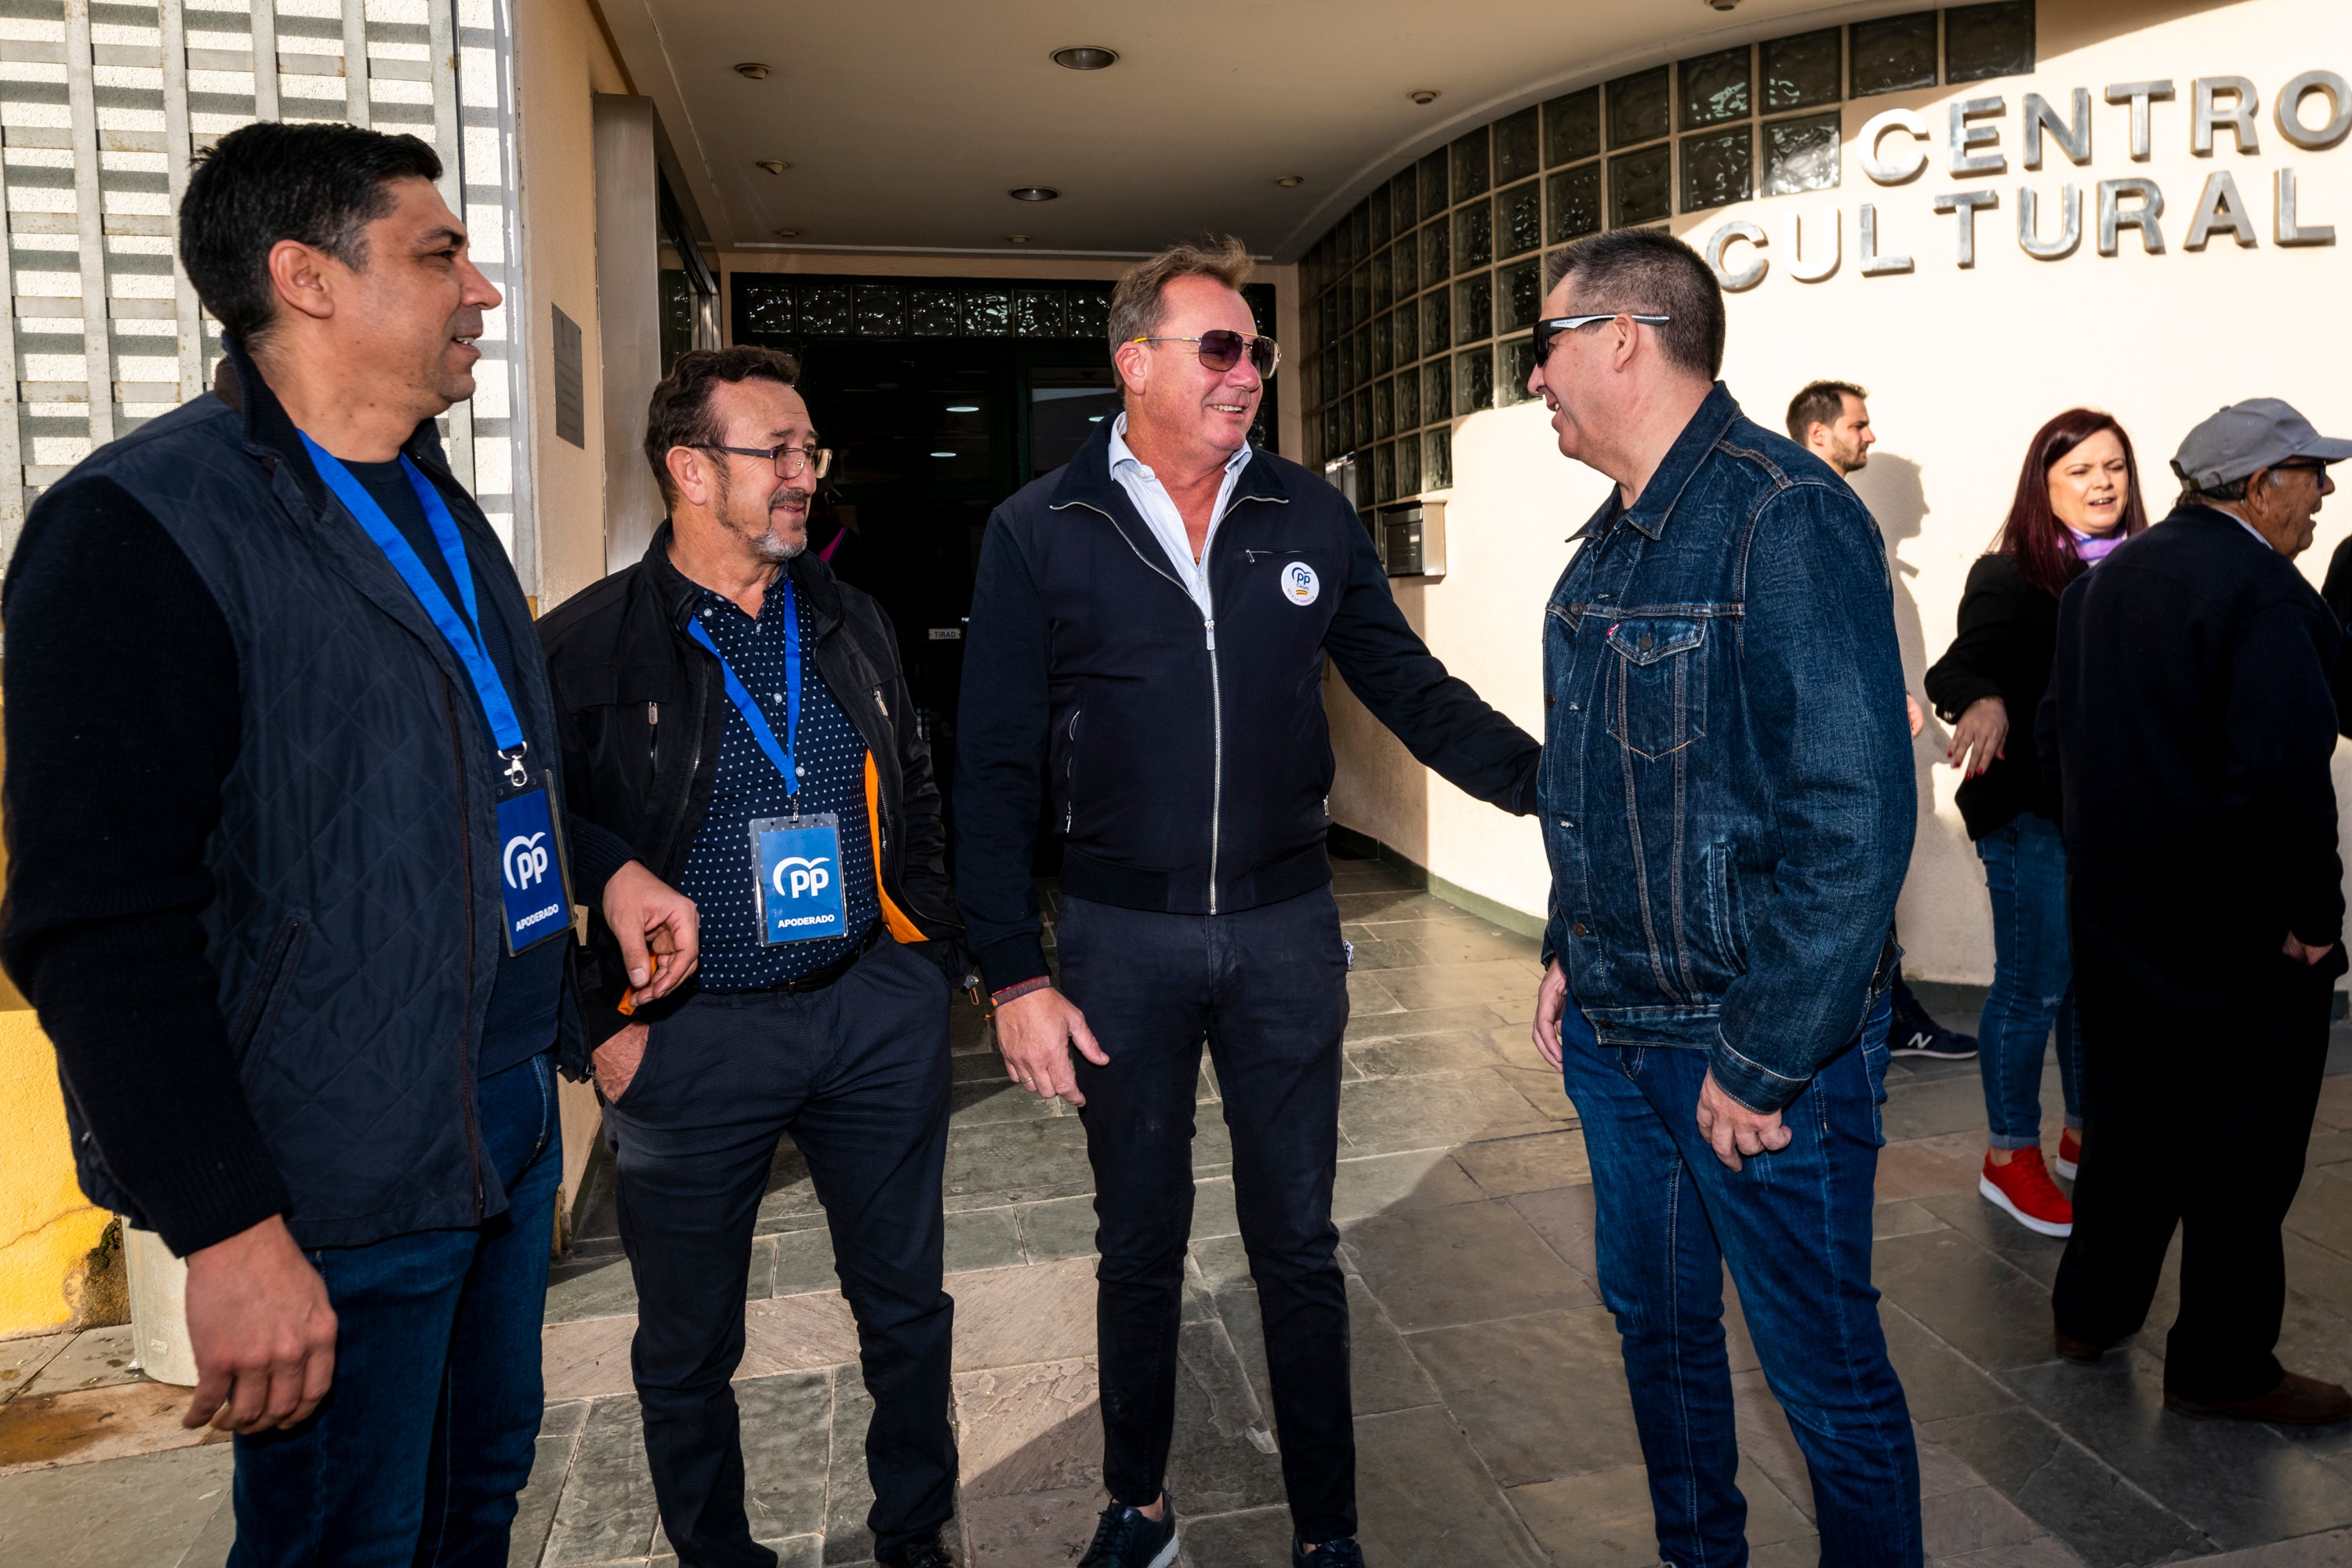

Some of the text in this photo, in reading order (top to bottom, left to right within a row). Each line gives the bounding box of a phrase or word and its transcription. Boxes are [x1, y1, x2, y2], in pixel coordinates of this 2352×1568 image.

[1857, 69, 2352, 185] CENTRO
[1706, 167, 2336, 292] CULTURAL
[516, 903, 559, 932] APODERADO
[778, 914, 835, 928] APODERADO
[1907, 1032, 1933, 1049] N
